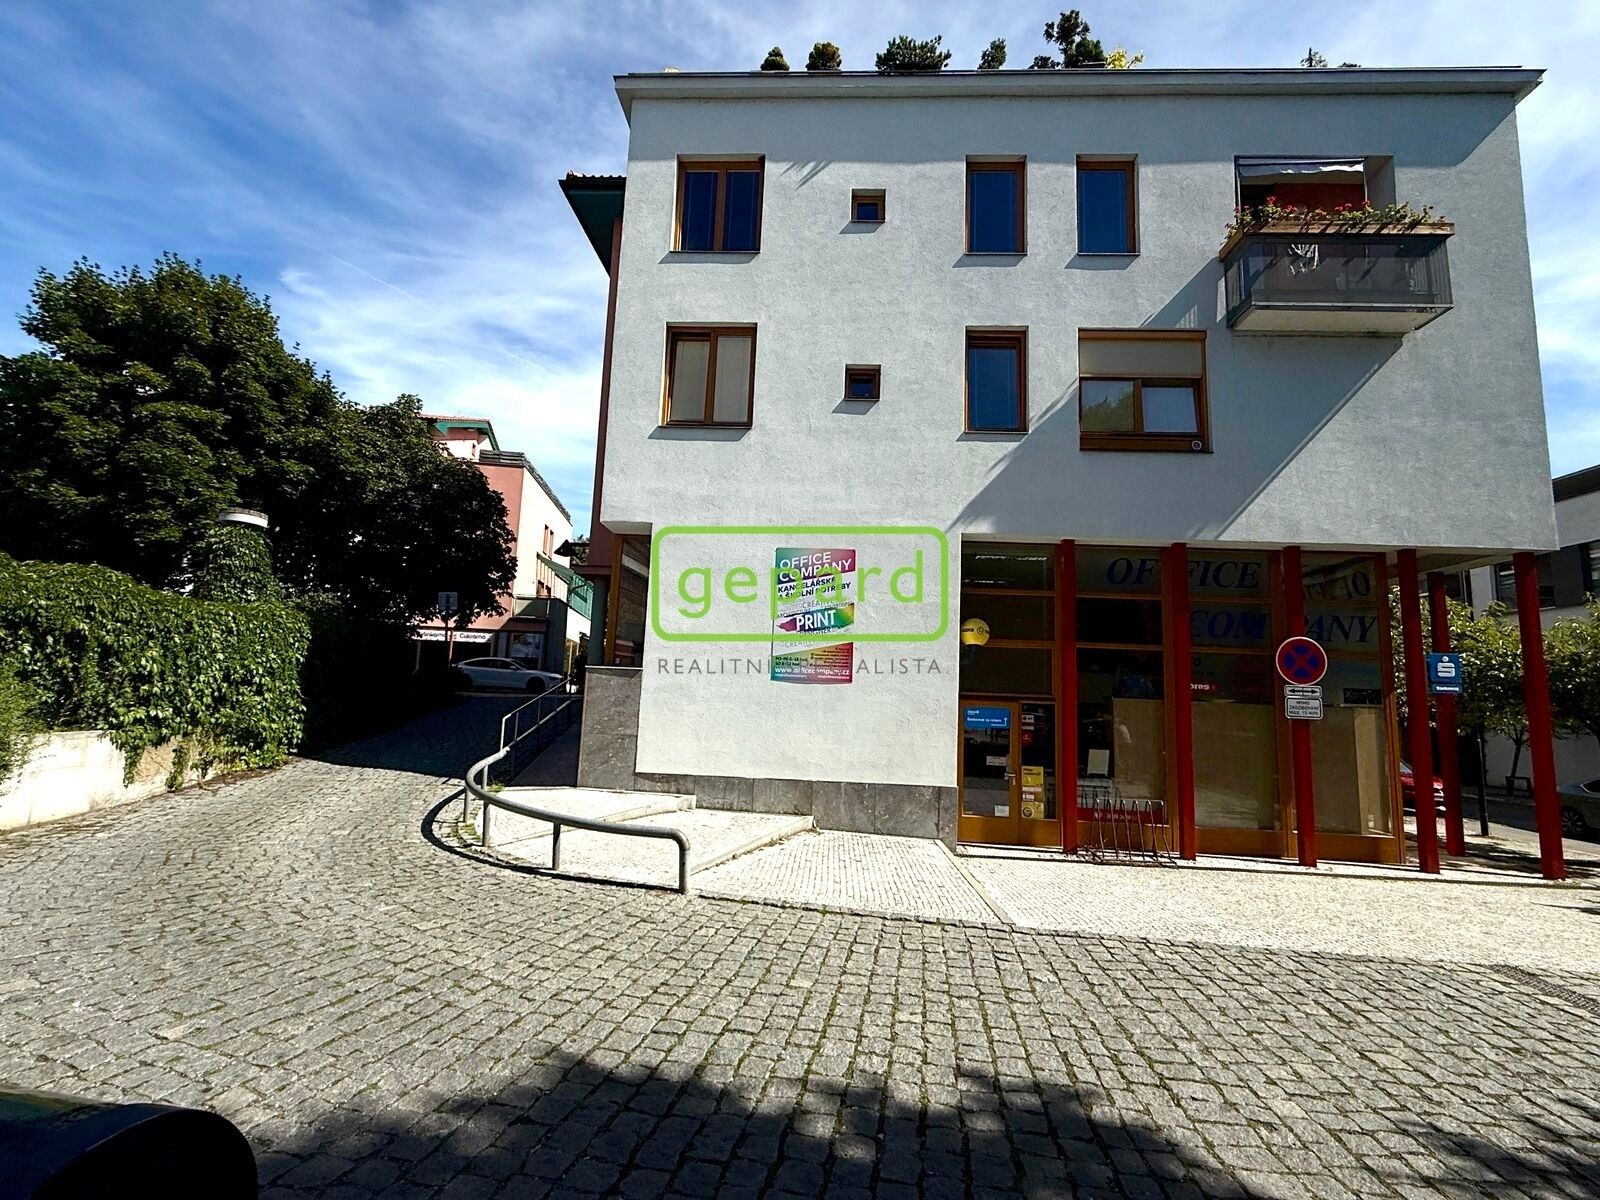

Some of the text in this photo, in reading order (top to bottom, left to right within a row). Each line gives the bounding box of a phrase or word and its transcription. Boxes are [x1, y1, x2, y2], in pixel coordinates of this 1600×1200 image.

[780, 551, 831, 568] OFFICE
[780, 558, 852, 581] COMPANY
[796, 610, 836, 631] PRINT
[1190, 610, 1379, 642] COMANY
